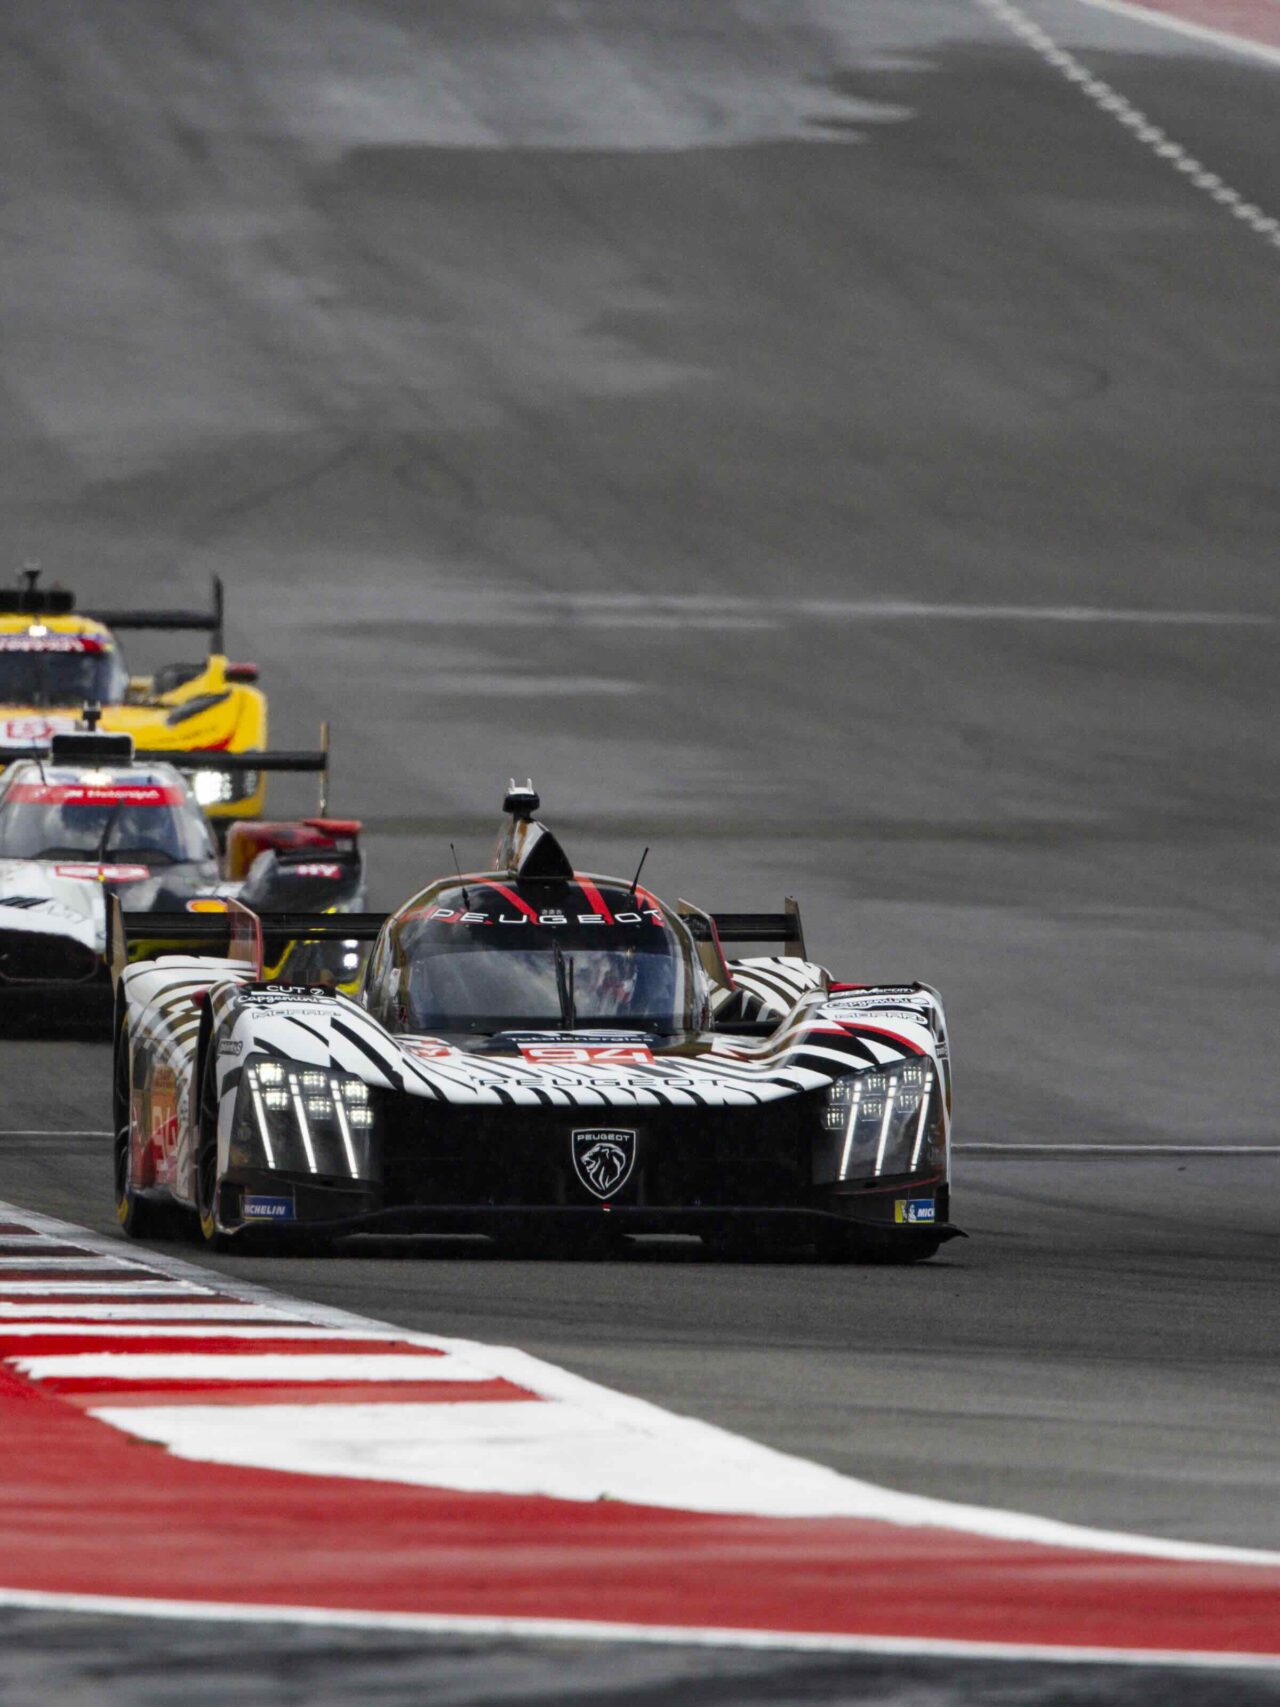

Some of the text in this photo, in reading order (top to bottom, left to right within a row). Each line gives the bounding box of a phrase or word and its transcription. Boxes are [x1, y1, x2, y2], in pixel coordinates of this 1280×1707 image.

[430, 908, 663, 925] PEUGEOT
[266, 985, 315, 994] CUT
[238, 995, 321, 1005] Capgemini
[528, 1048, 650, 1063] 94
[477, 1078, 728, 1087] PEUGEOT
[577, 1133, 631, 1142] PEUGEOT
